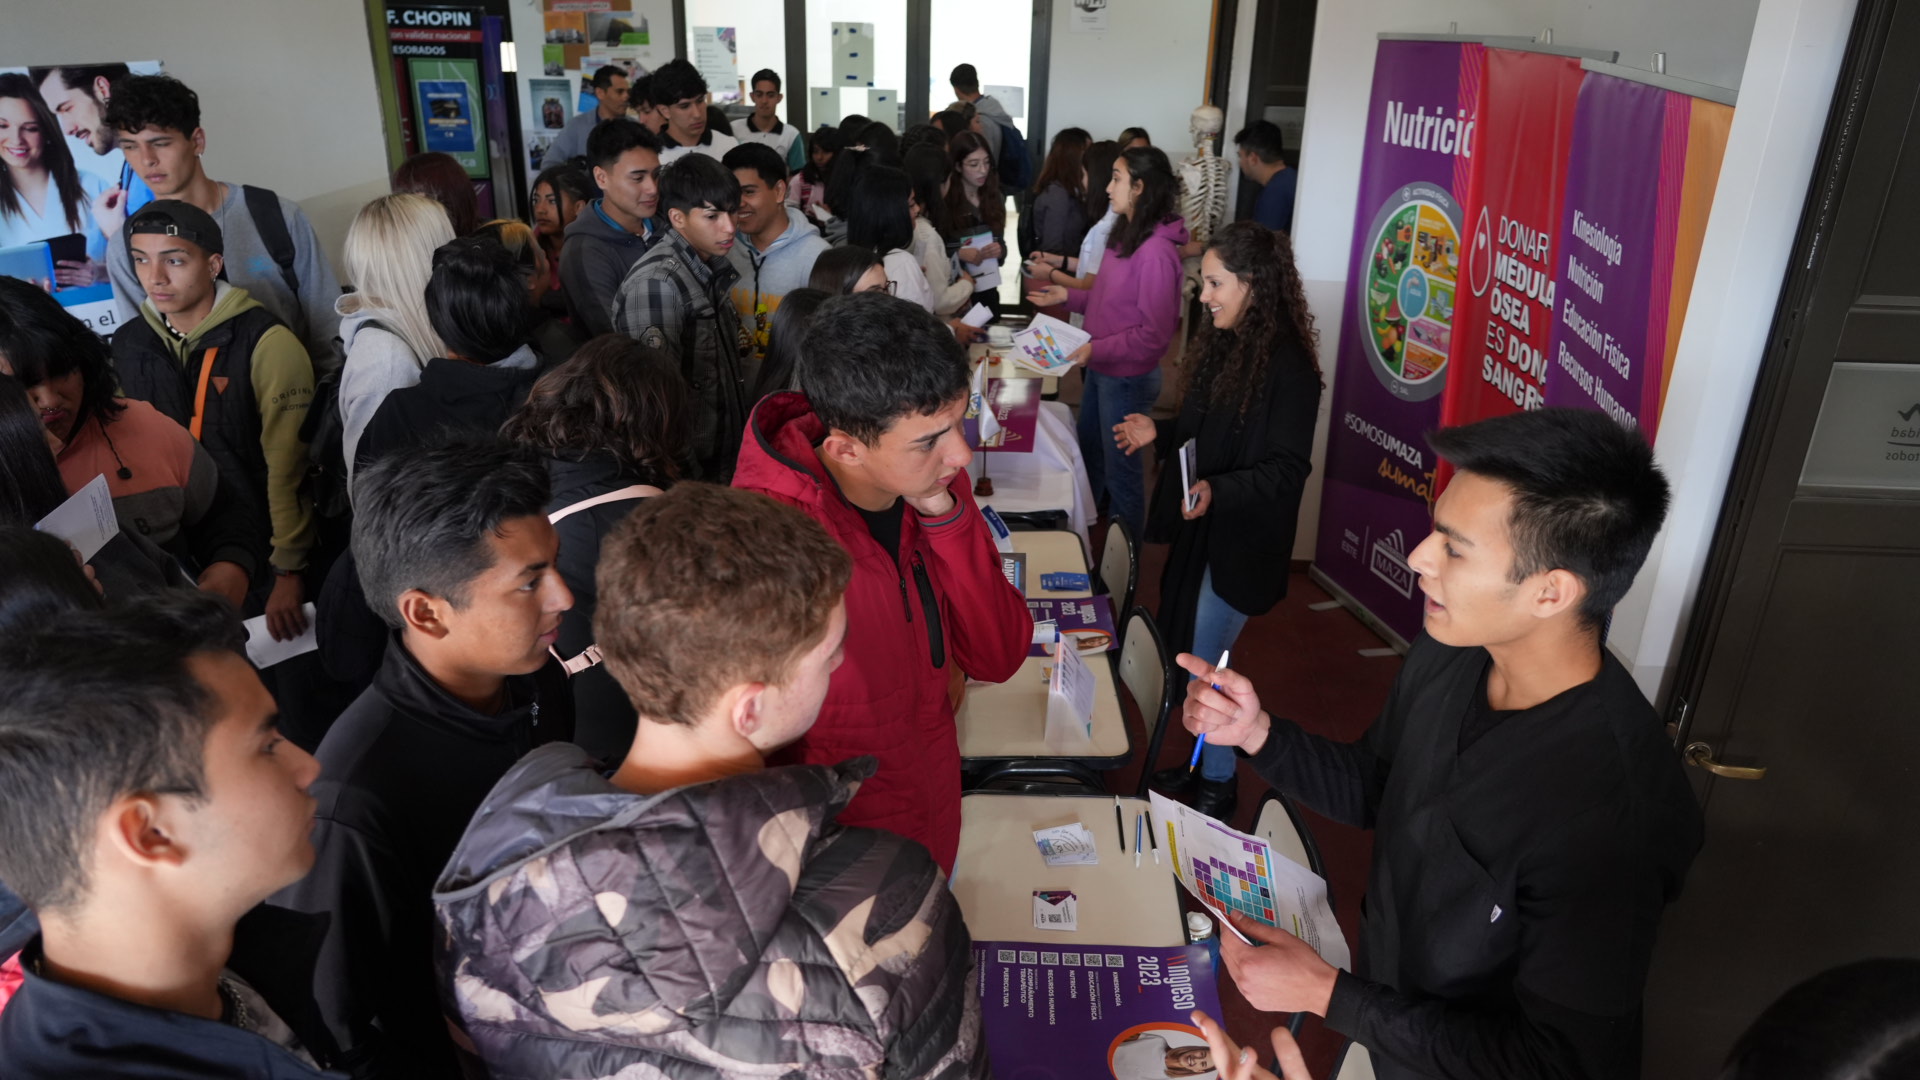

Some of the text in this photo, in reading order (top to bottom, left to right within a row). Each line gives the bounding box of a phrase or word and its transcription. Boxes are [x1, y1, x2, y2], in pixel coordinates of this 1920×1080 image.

[402, 10, 472, 27] CHOPIN
[404, 30, 433, 40] validez
[435, 31, 471, 41] nacional
[1498, 215, 1550, 265] DONAR
[1572, 209, 1623, 266] Kinesiología
[1494, 251, 1556, 311] MÉDULA
[1567, 254, 1604, 304] Nutrición
[99, 309, 116, 326] el
[1490, 281, 1530, 335] ÓSEA
[1485, 320, 1506, 354] ES
[1562, 298, 1631, 380] Educación Física
[1558, 340, 1637, 431] Recursos Humanos
[1343, 411, 1423, 470] #SOMOSUMAZA
[1376, 554, 1408, 589] MAZA
[1002, 967, 1010, 1008] PUERICULTURA
[1027, 968, 1035, 1018] ACOMPAÑAMIENTO
[1069, 969, 1077, 999] NUTRICIÓN
[1087, 970, 1098, 1021] EDUCACIÓN FÍSICA
[1137, 955, 1162, 986] 2023
[1163, 964, 1196, 1010] Ingreso
[1047, 969, 1056, 1025] RECURSOS HUMANOS
